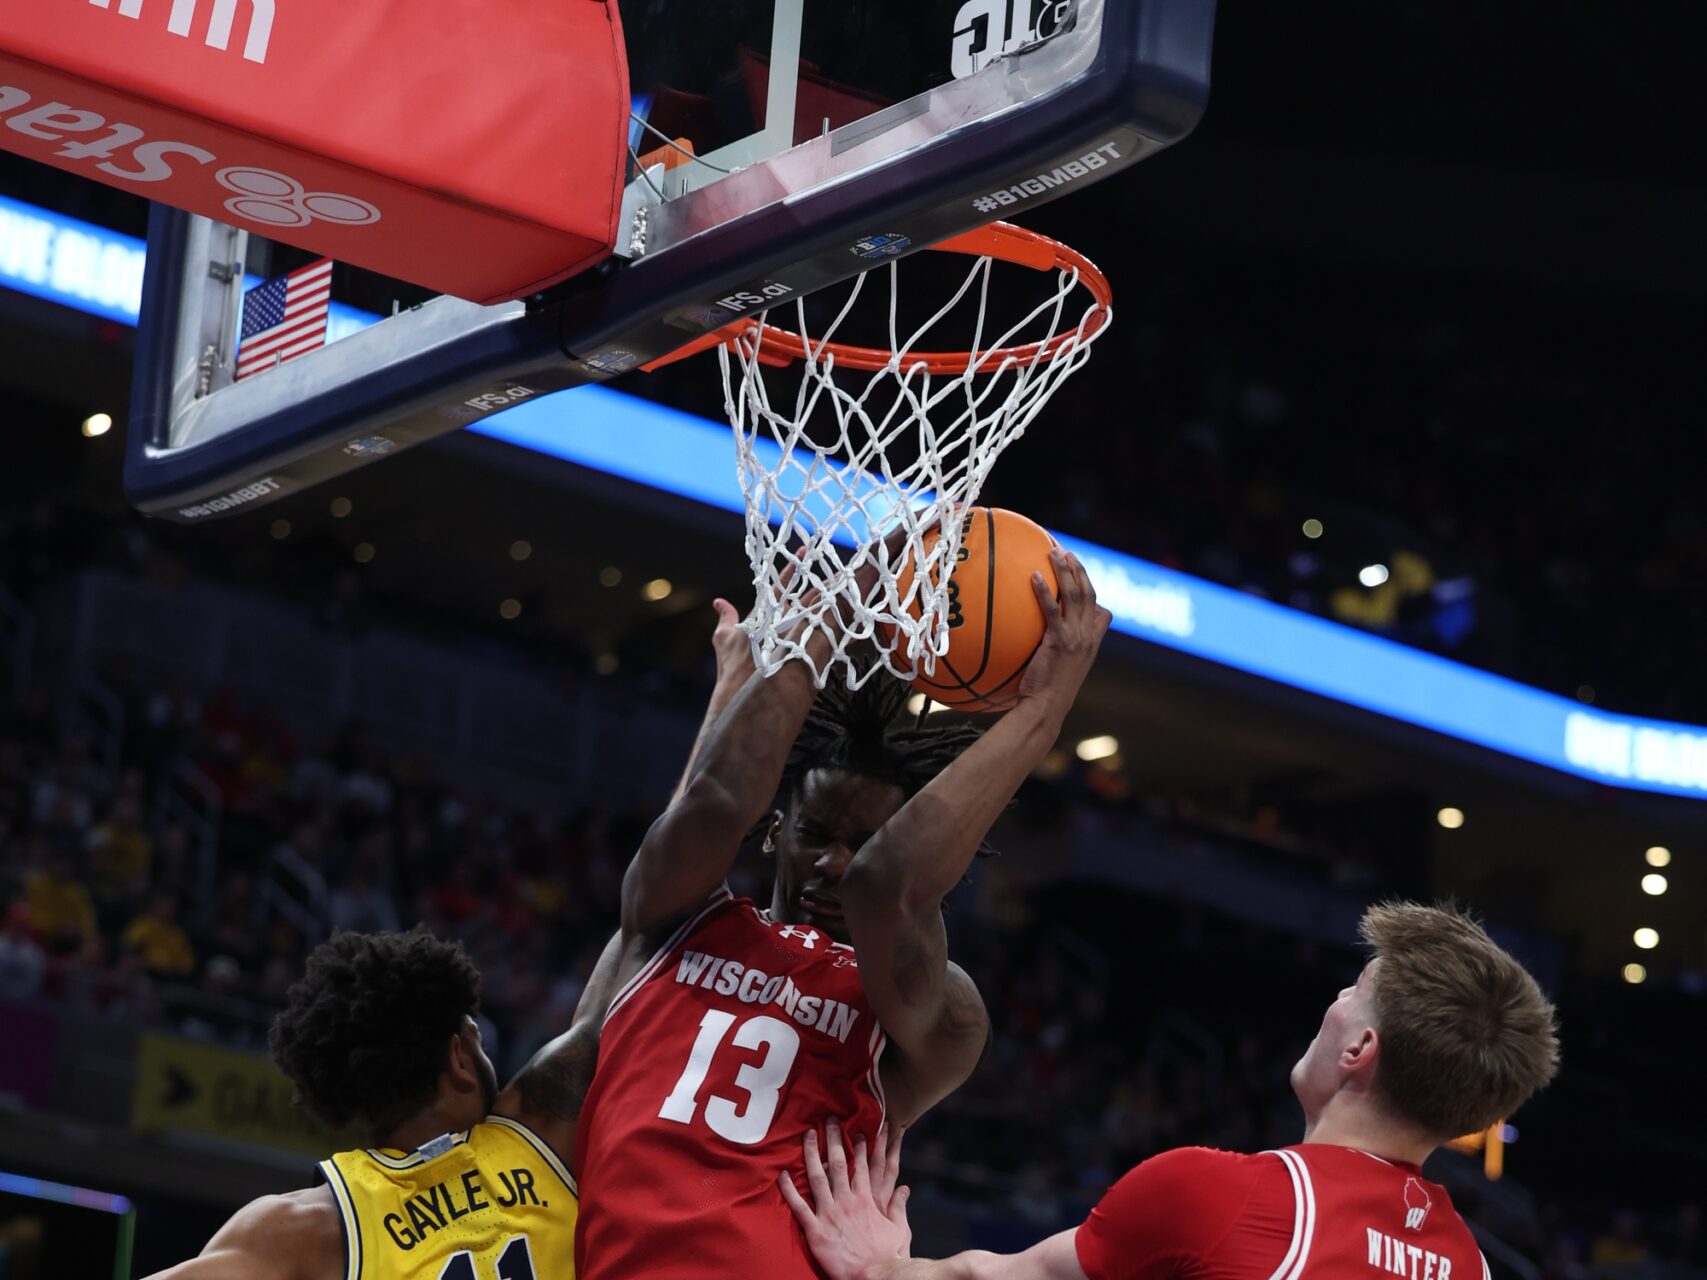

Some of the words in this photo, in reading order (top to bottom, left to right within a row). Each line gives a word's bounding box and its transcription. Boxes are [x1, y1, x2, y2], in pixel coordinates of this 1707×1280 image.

[972, 142, 1121, 213] #B1GMBBT
[715, 280, 793, 312] IFS.ai
[465, 384, 535, 412] IFS.ai
[675, 950, 860, 1045] WISCONSIN
[658, 1008, 801, 1145] 13
[383, 1169, 490, 1250] GAYLE
[497, 1168, 549, 1208] JR.
